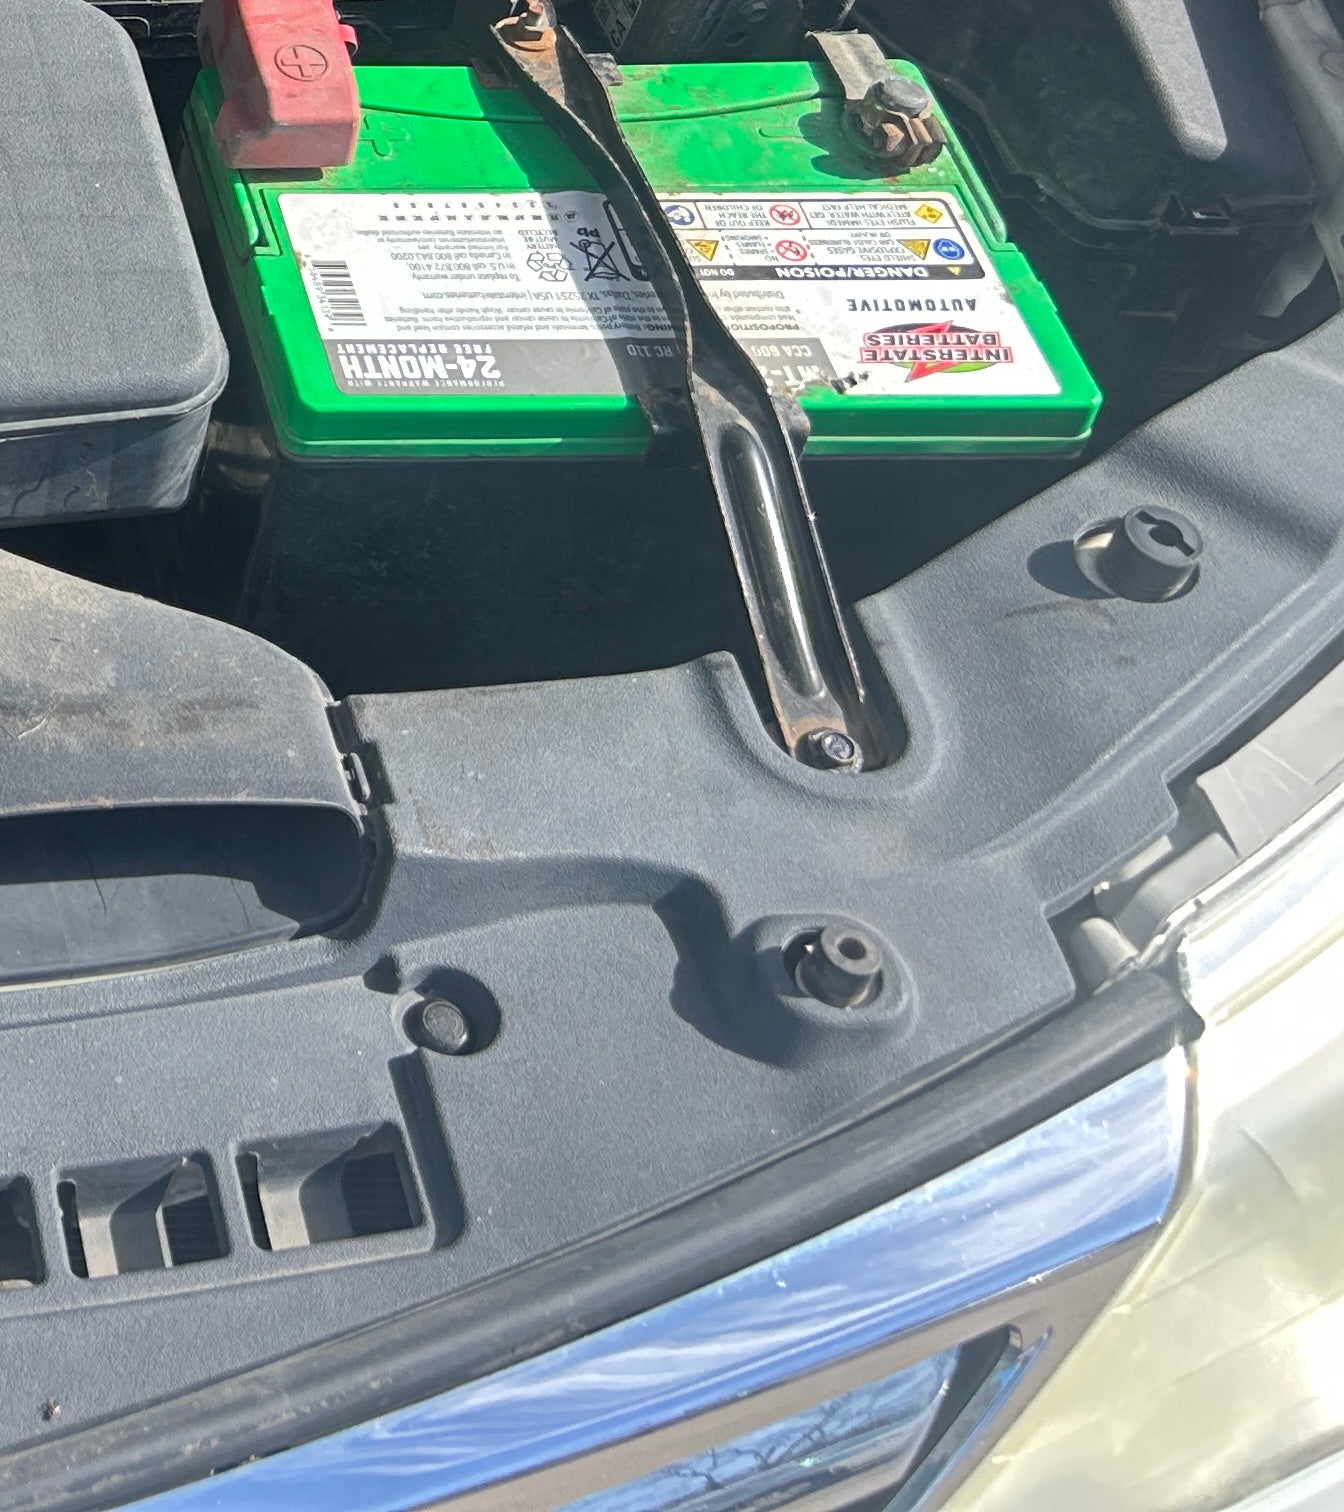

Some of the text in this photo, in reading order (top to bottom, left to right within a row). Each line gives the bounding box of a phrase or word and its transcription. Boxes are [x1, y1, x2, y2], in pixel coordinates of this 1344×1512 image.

[576, 228, 600, 238] Pb
[478, 272, 507, 281] replace
[700, 267, 928, 277] DANGER/POISON DO NOT
[533, 292, 552, 300] USA
[587, 292, 597, 300] TX
[847, 299, 976, 312] AUTOMOTIVE
[866, 334, 996, 346] BATTERIES
[337, 344, 492, 353] FREE REPLACEMENT
[653, 344, 672, 356] RC
[781, 345, 812, 357] CCA
[863, 349, 1009, 361] INTERSTATE
[339, 355, 501, 378] 24-MONTH
